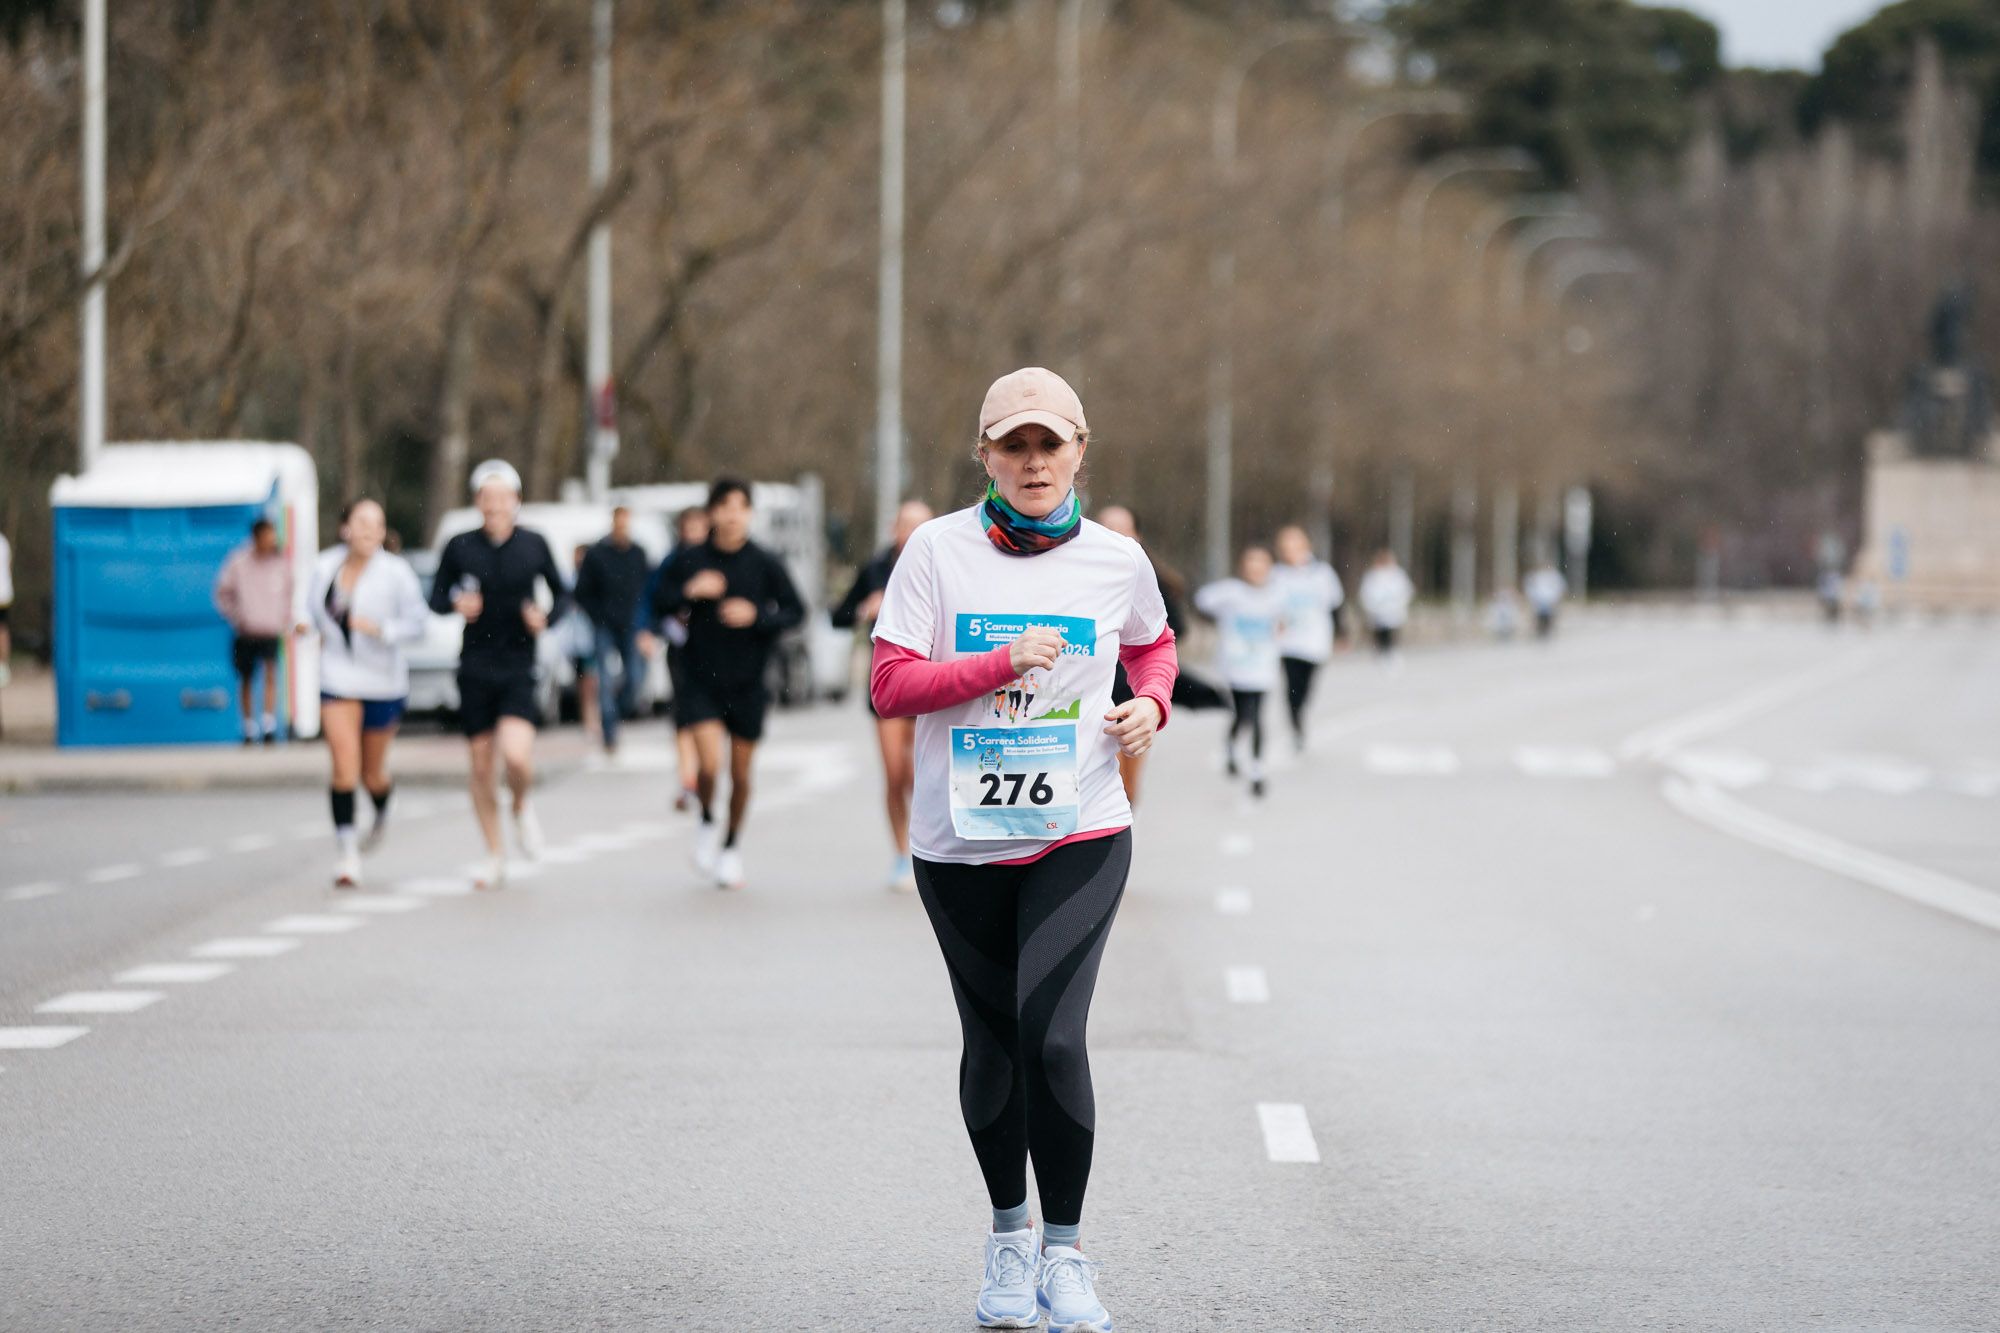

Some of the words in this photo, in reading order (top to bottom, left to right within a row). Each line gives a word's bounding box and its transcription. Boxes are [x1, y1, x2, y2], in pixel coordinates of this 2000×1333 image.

[984, 622, 1024, 632] Carrera
[978, 736, 1015, 746] Carrera
[1017, 735, 1058, 746] Solidaria
[980, 772, 1054, 806] 276
